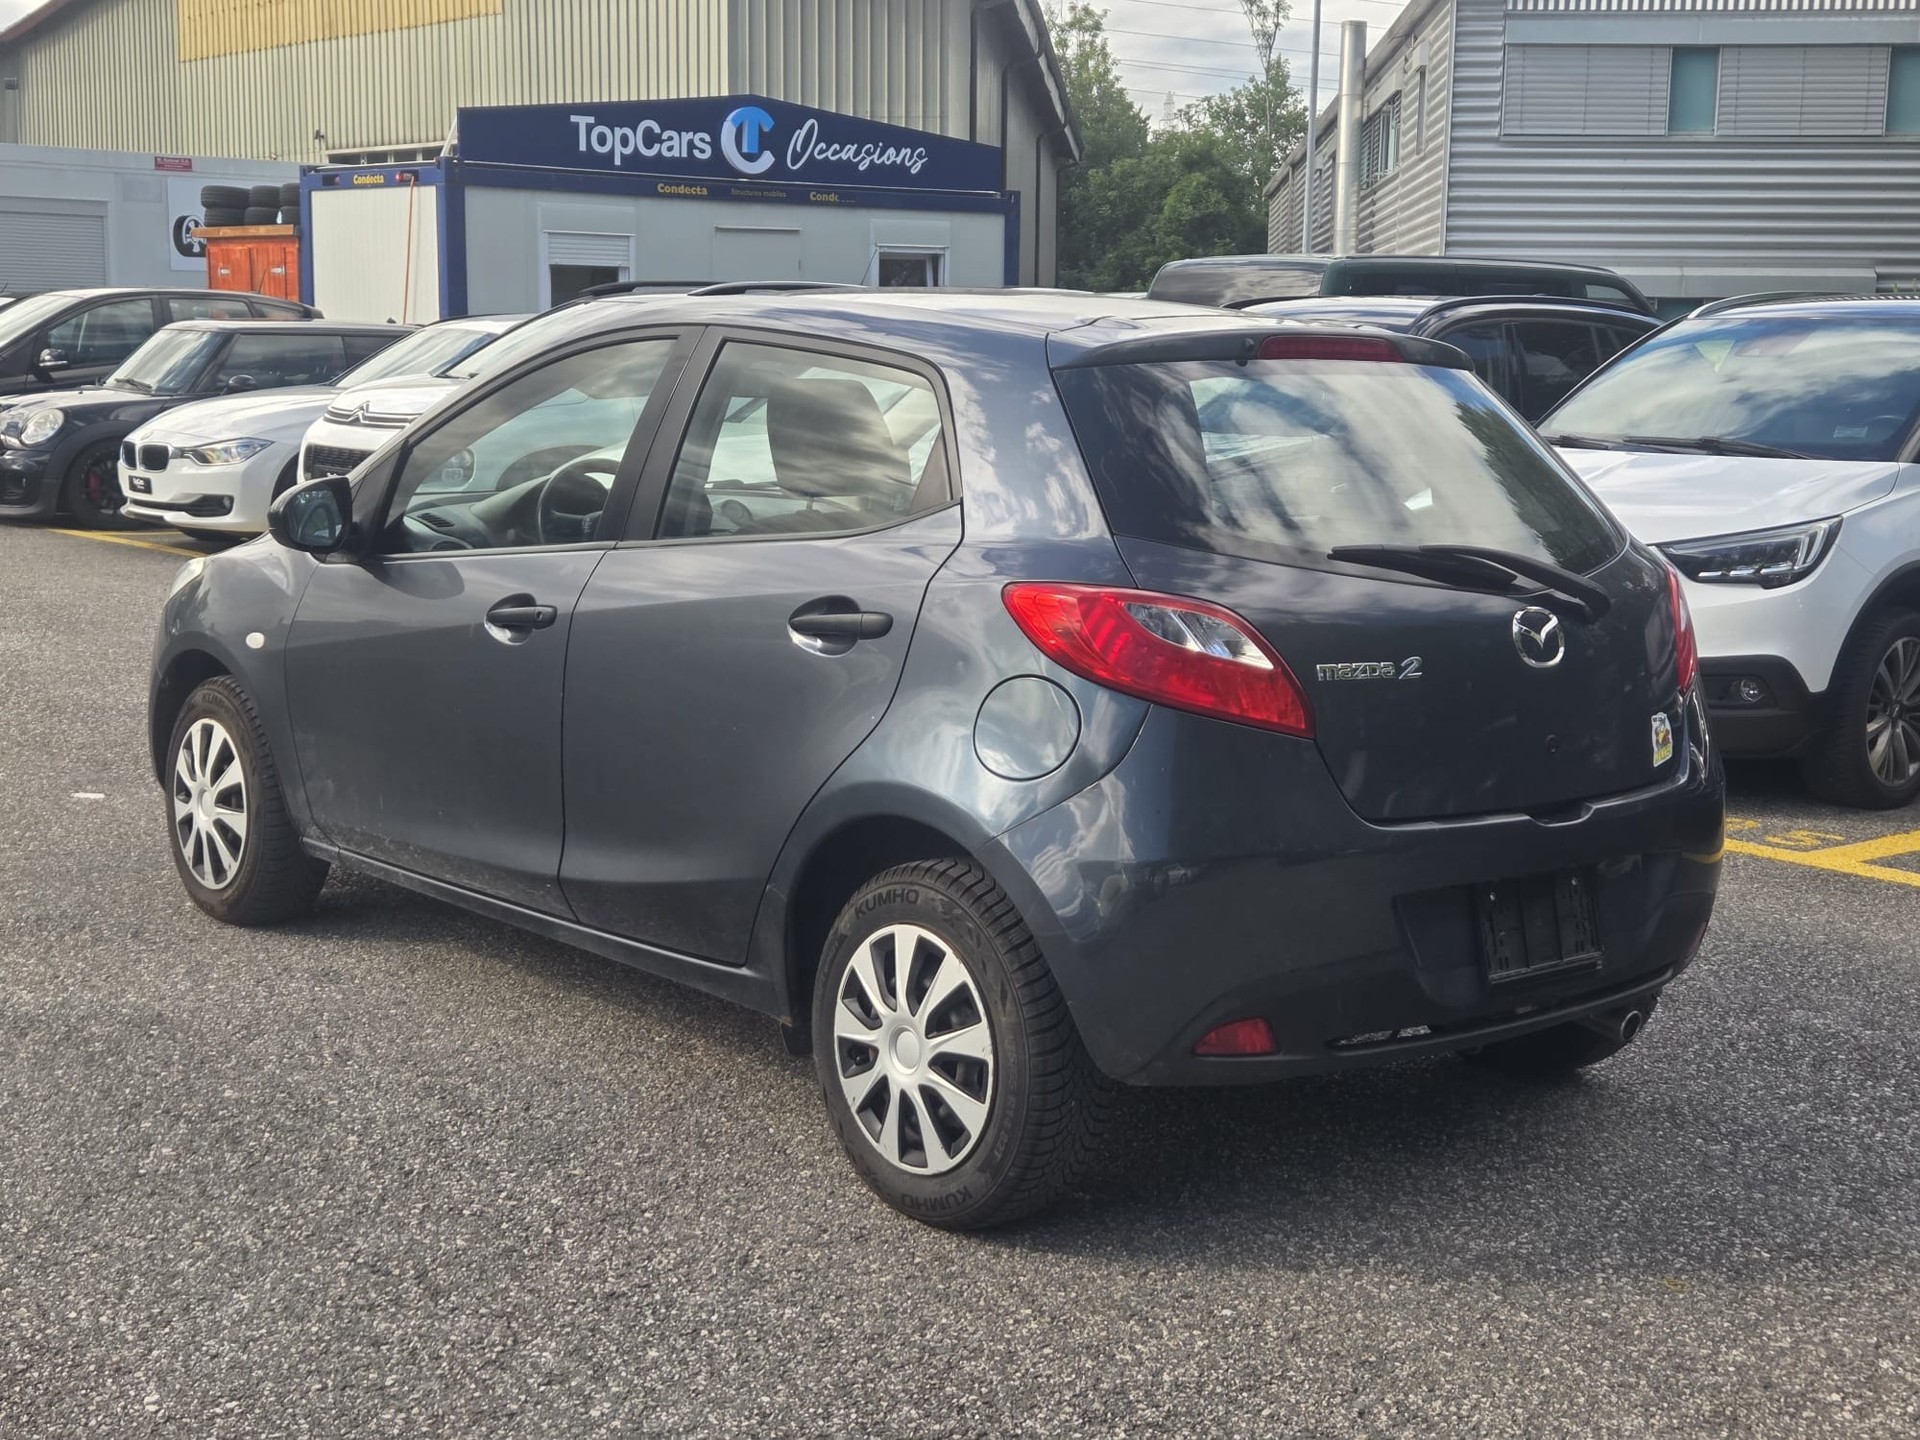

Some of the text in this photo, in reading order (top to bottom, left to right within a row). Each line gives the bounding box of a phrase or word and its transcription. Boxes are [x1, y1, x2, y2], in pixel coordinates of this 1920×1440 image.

[570, 115, 712, 166] TopCars
[786, 118, 928, 174] Occasions
[353, 174, 385, 185] Condecta
[657, 183, 708, 196] Condecta
[1399, 656, 1423, 679] 2
[854, 888, 920, 920] KUMHO
[902, 1185, 973, 1211] KUMHO
